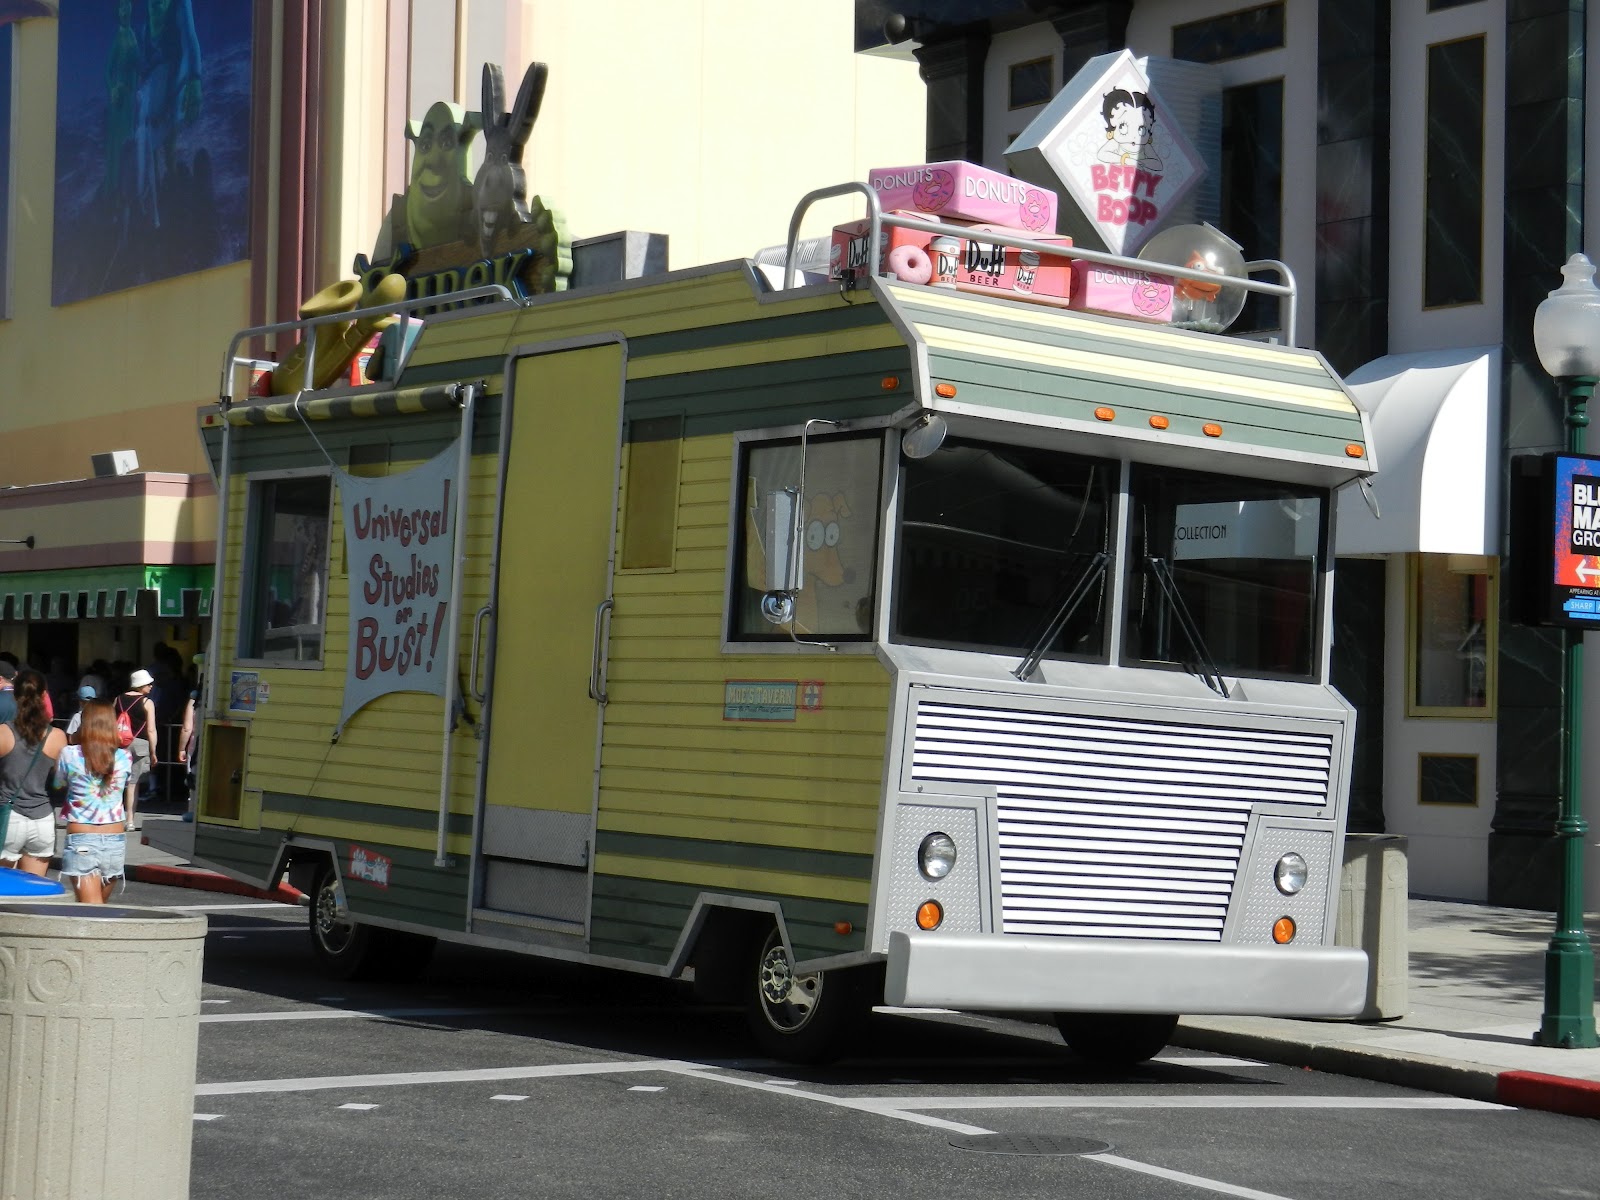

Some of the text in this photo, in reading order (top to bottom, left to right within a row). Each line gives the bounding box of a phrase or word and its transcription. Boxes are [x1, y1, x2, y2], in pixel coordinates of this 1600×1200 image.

[873, 167, 933, 192] DONUTS
[965, 176, 1027, 204] DONUTS
[1091, 163, 1163, 198] BETTY
[1097, 194, 1158, 226] BOOP
[849, 232, 870, 268] Duff
[967, 239, 1004, 277] Duff
[969, 275, 999, 286] BEER
[1095, 269, 1151, 285] DONUTS
[353, 479, 450, 547] Universal
[396, 606, 413, 625] or
[1571, 601, 1592, 610] SHARP
[355, 601, 448, 681] Bust!
[756, 686, 793, 705] TAVERN
